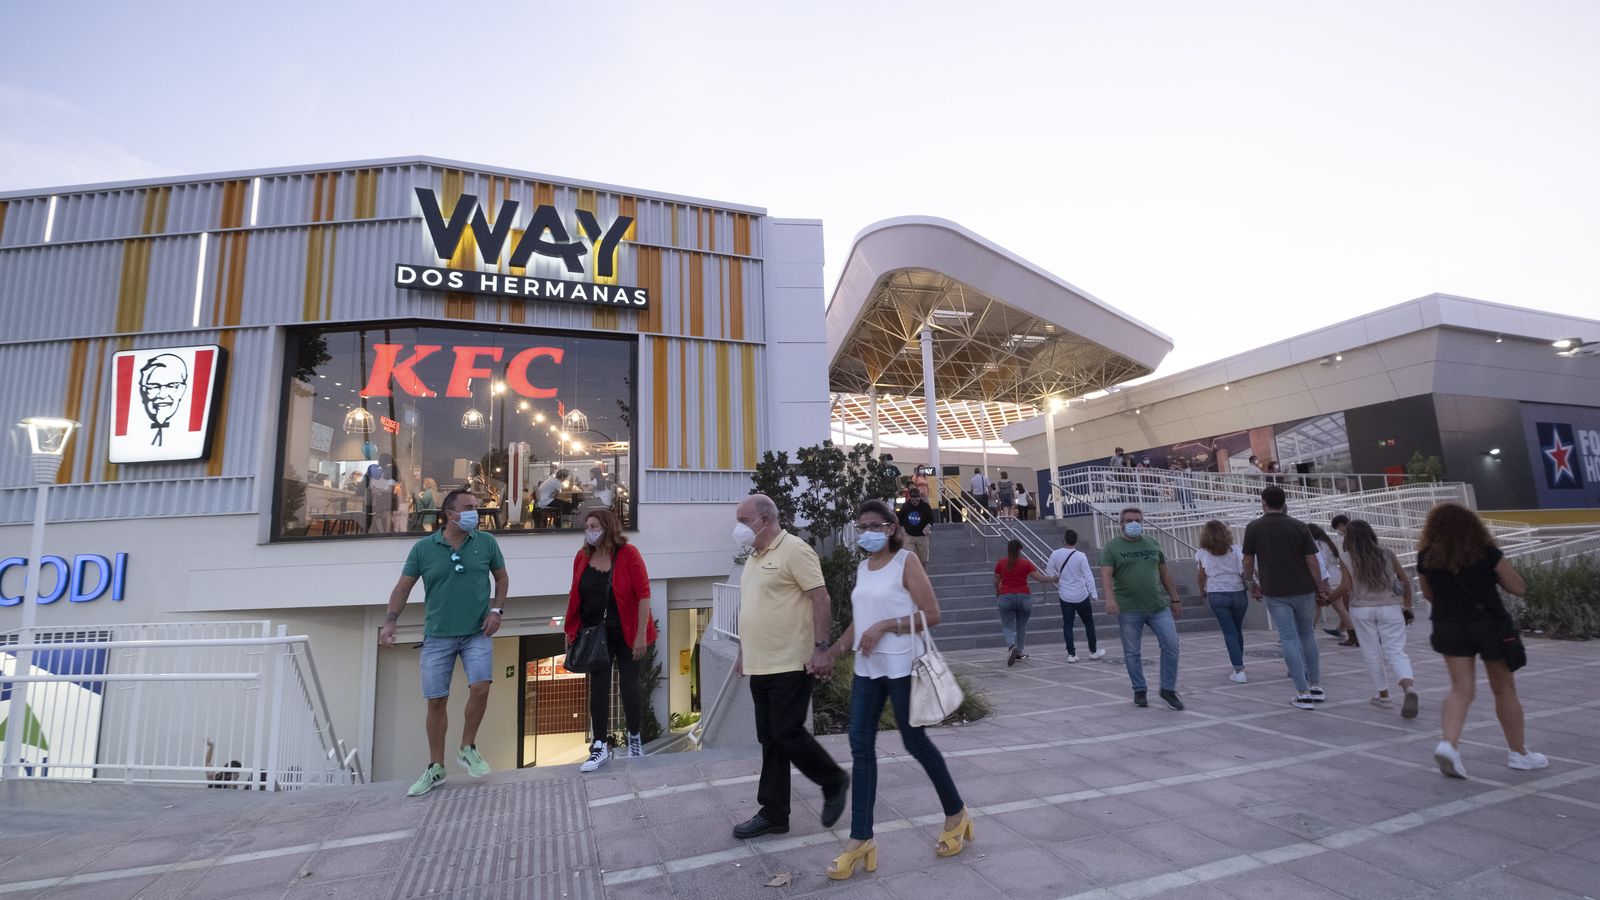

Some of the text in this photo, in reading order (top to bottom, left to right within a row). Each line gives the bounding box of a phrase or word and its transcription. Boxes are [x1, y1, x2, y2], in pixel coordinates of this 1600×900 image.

[415, 187, 634, 277] WAY
[397, 266, 647, 306] DOS HERMANAS
[359, 343, 564, 398] KFC
